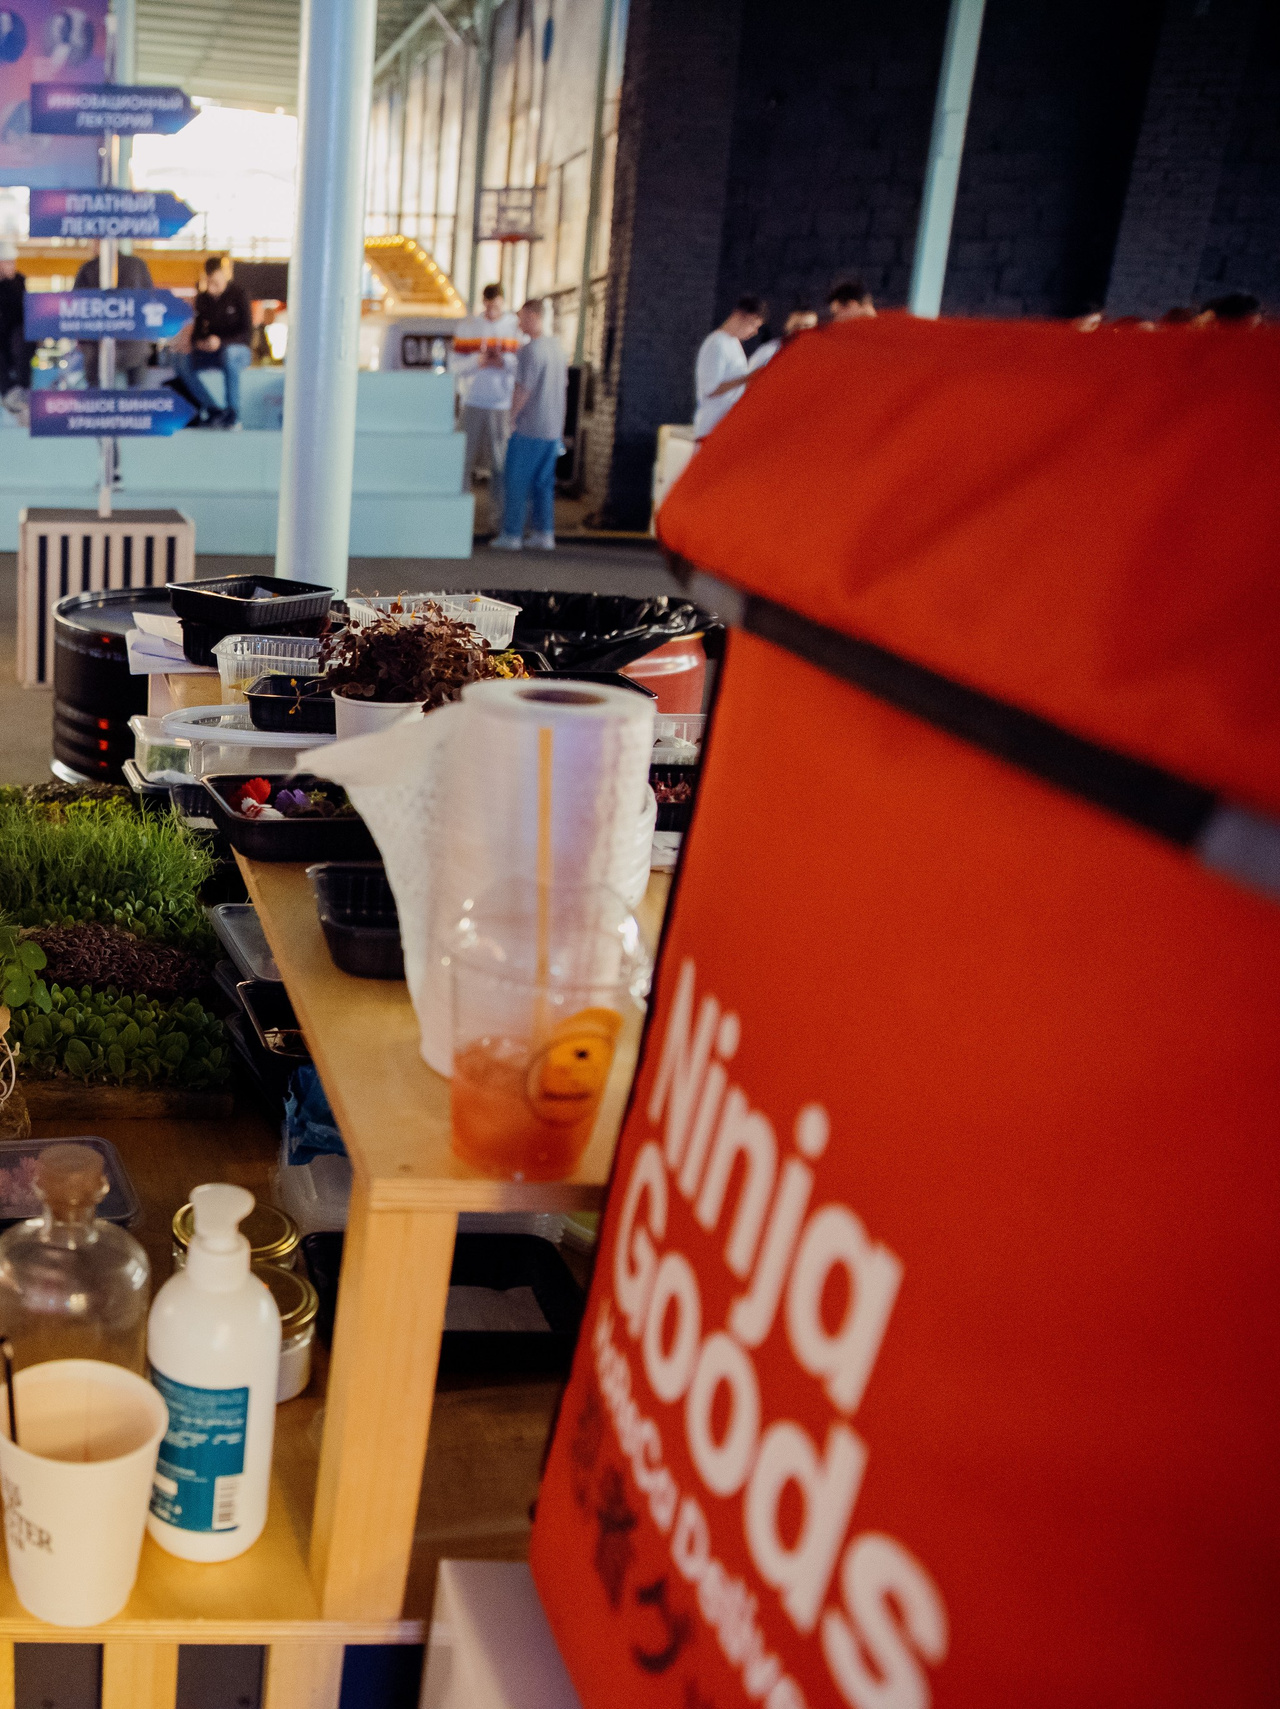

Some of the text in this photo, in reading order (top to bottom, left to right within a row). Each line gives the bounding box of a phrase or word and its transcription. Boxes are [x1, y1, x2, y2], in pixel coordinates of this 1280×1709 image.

[76, 111, 153, 128] ЛЕКТОРИЙ
[65, 193, 156, 213] ПЛАТНЫЙ
[61, 214, 160, 236] ЛЕКТОРИЙ
[59, 298, 135, 319] MERCH
[45, 397, 174, 414] БОЛЬШОЕ ВИННОЕ
[649, 957, 904, 1416] Ninja
[613, 1140, 950, 1709] Goods
